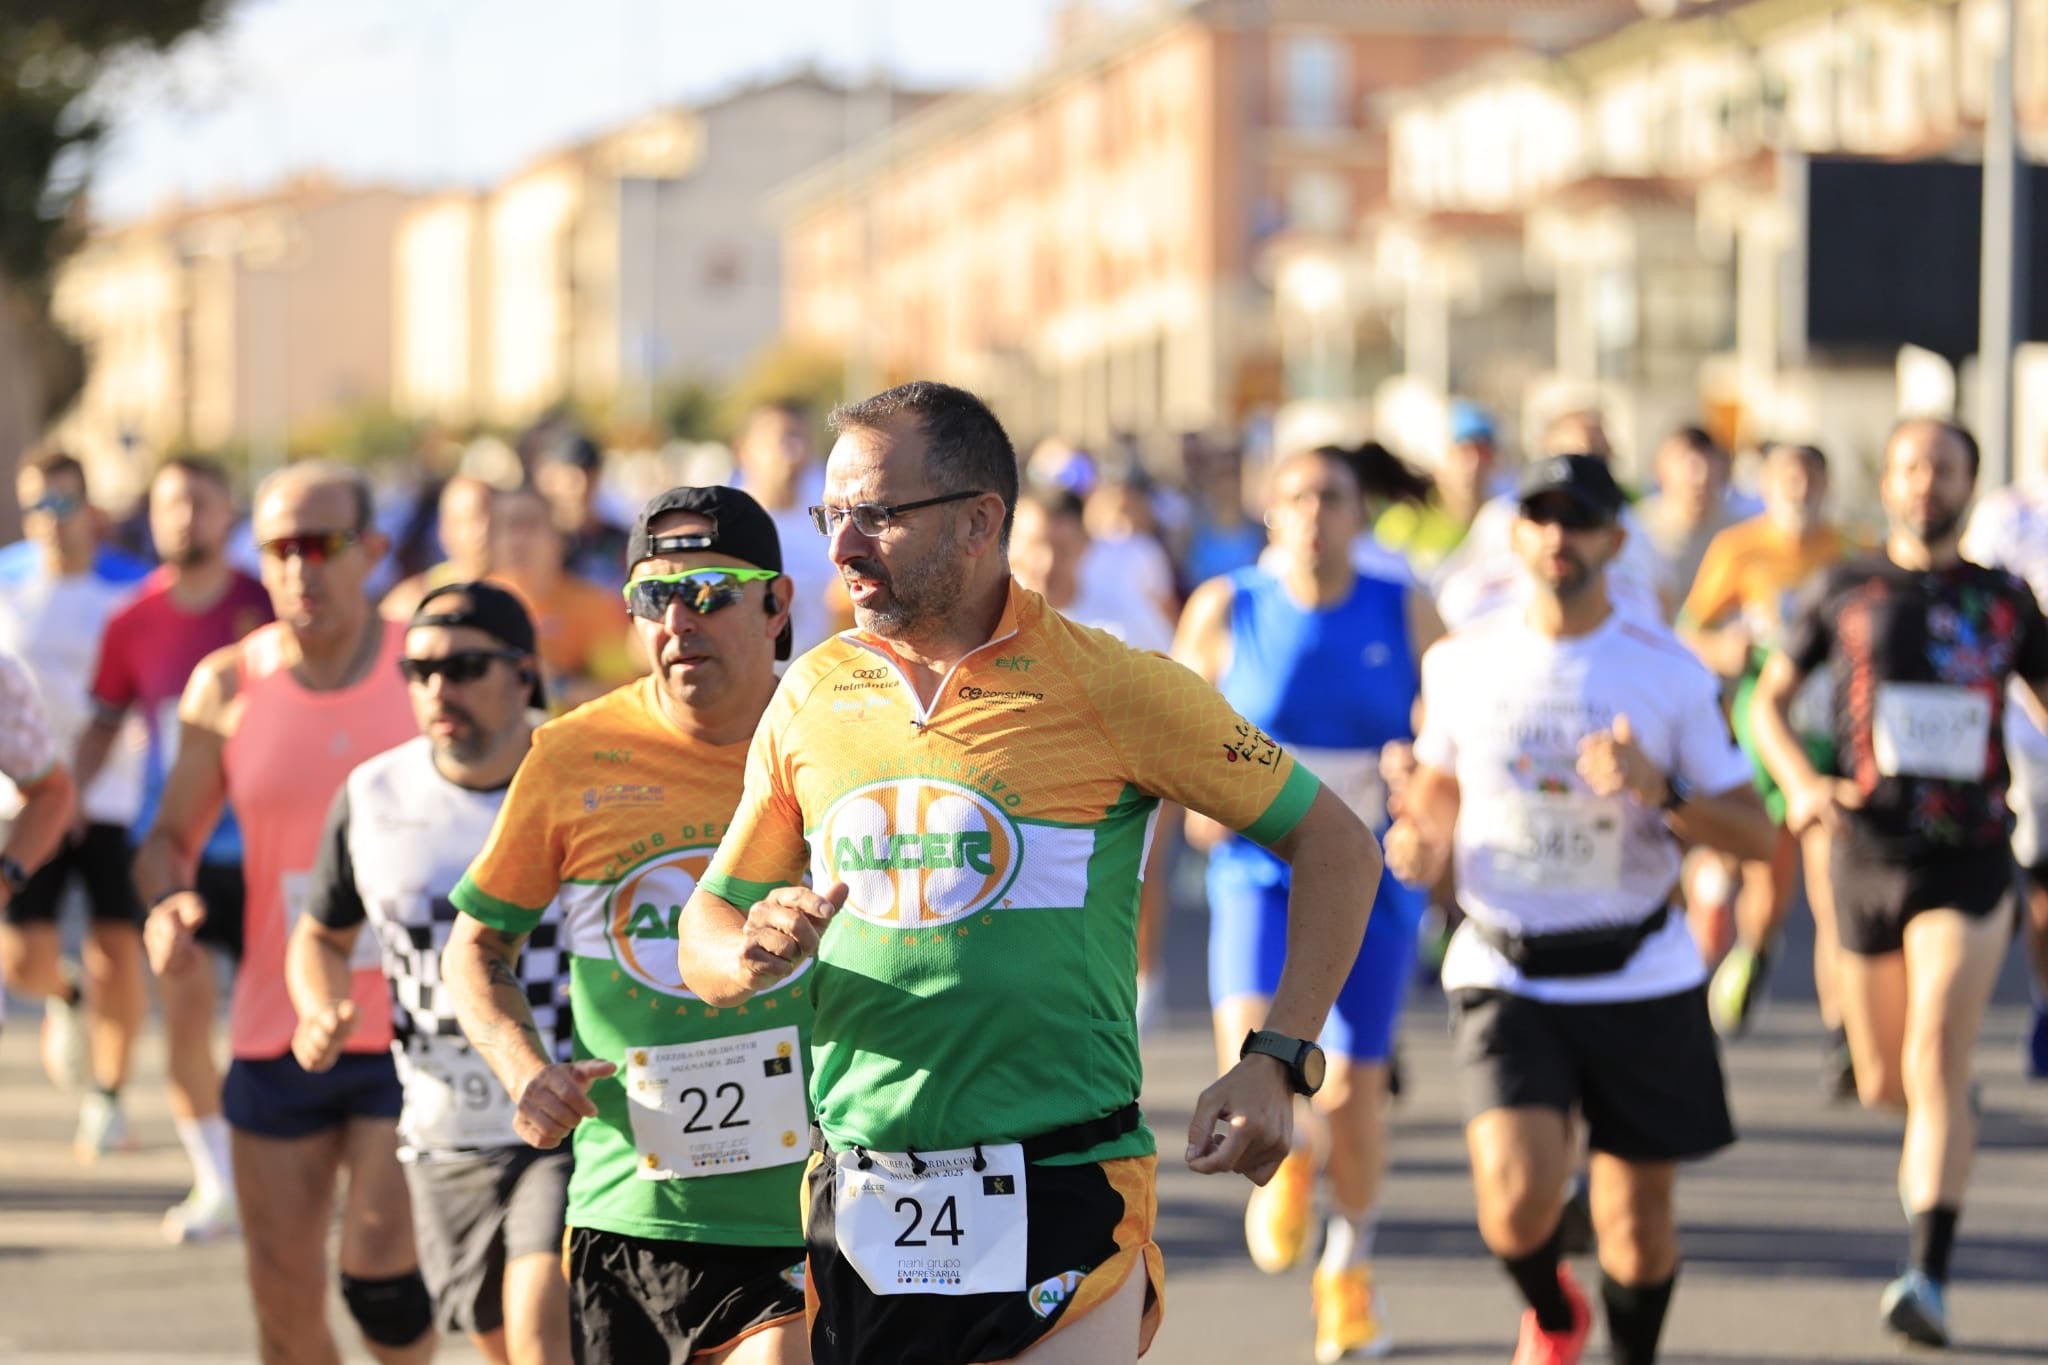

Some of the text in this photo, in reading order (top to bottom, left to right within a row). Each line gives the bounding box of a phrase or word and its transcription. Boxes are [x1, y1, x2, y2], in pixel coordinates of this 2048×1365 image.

[996, 656, 1035, 672] EKT
[603, 832, 666, 878] CLUB
[834, 831, 996, 876] ALCER
[843, 897, 1013, 946] ALAMANCA
[612, 969, 802, 1018] SALAMANC
[679, 1081, 750, 1134] 22
[943, 1168, 964, 1177] 2025
[894, 1195, 965, 1247] 24
